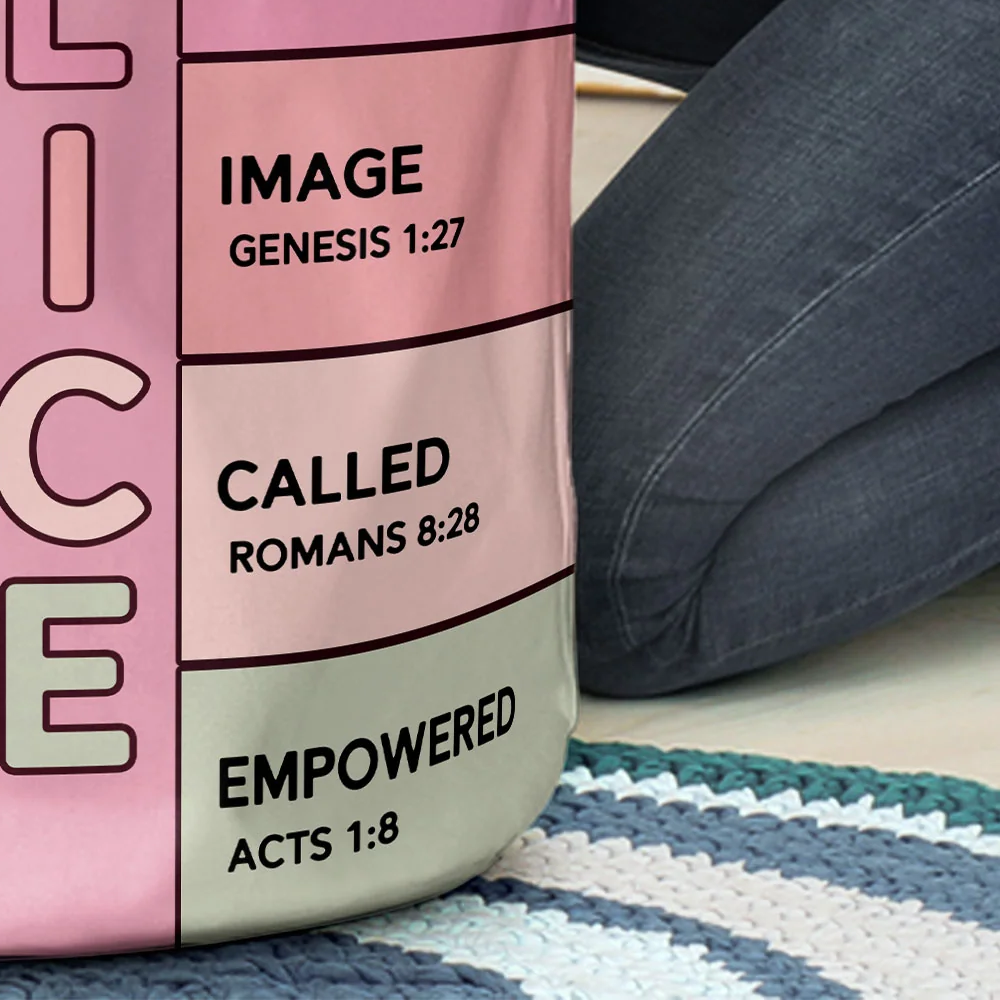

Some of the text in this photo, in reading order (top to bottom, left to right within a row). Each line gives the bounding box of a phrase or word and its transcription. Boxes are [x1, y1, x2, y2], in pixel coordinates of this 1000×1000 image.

[221, 144, 423, 206] IMAGE
[229, 216, 465, 268] GENESIS 1:27
[217, 437, 450, 512] CALLED
[230, 501, 480, 574] ROMANS 8:28
[219, 686, 517, 809] EMPOWERED
[228, 811, 399, 873] ACTS 1:8
